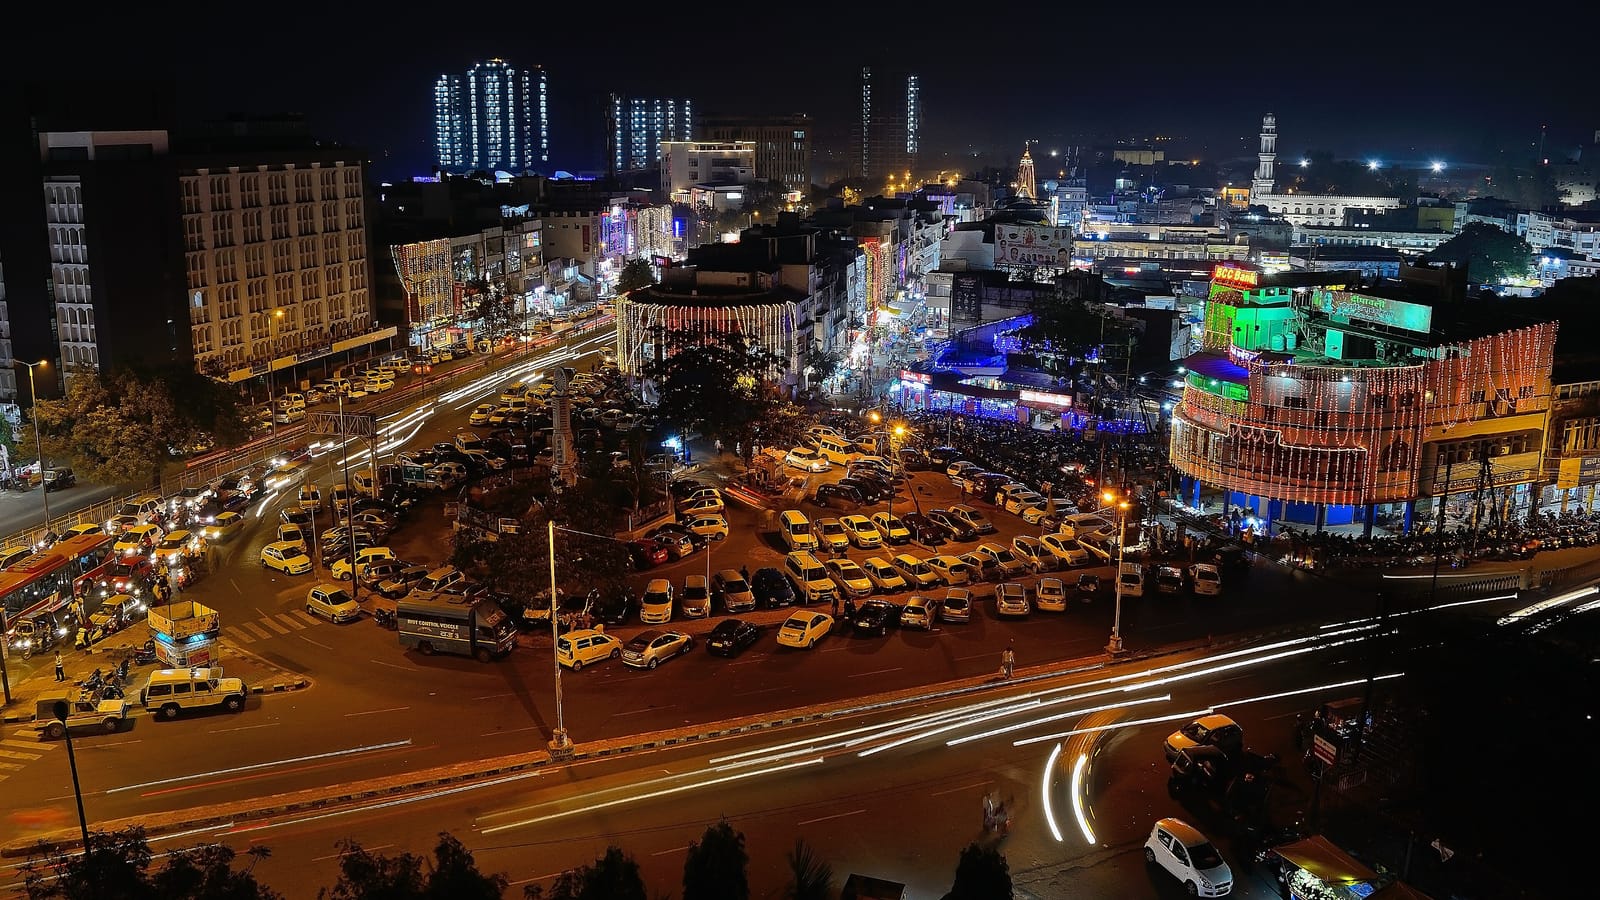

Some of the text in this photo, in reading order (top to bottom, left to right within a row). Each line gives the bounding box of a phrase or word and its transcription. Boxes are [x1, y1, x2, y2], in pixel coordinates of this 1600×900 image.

[1215, 266, 1256, 285] BCC Bank
[418, 620, 440, 628] CONTROL
